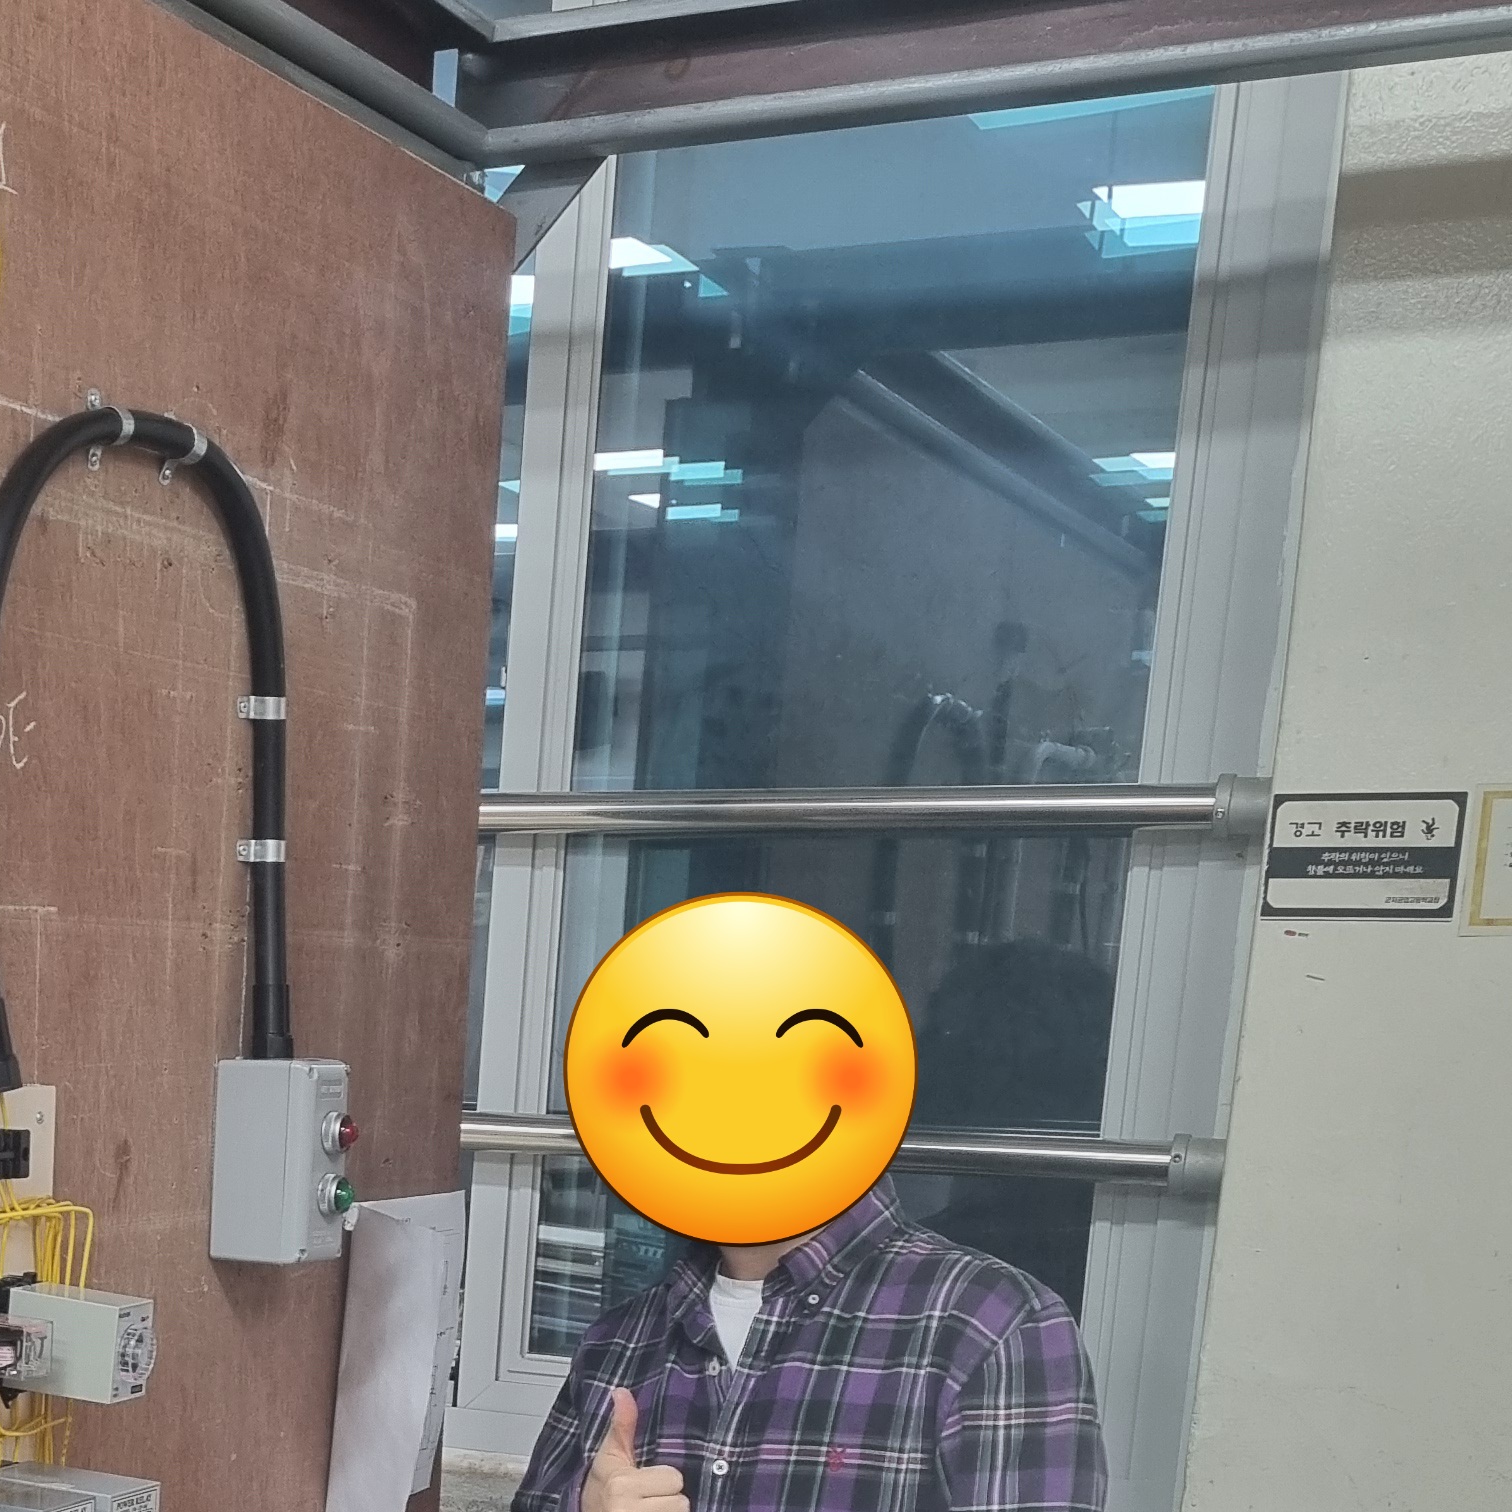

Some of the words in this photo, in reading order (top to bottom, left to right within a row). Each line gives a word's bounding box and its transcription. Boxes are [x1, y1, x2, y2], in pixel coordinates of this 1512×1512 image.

[1289, 821, 1323, 838] 경고
[1335, 820, 1407, 839] 추락위험
[116, 1499, 135, 1512] POWER
[135, 1494, 152, 1505] RELAY
